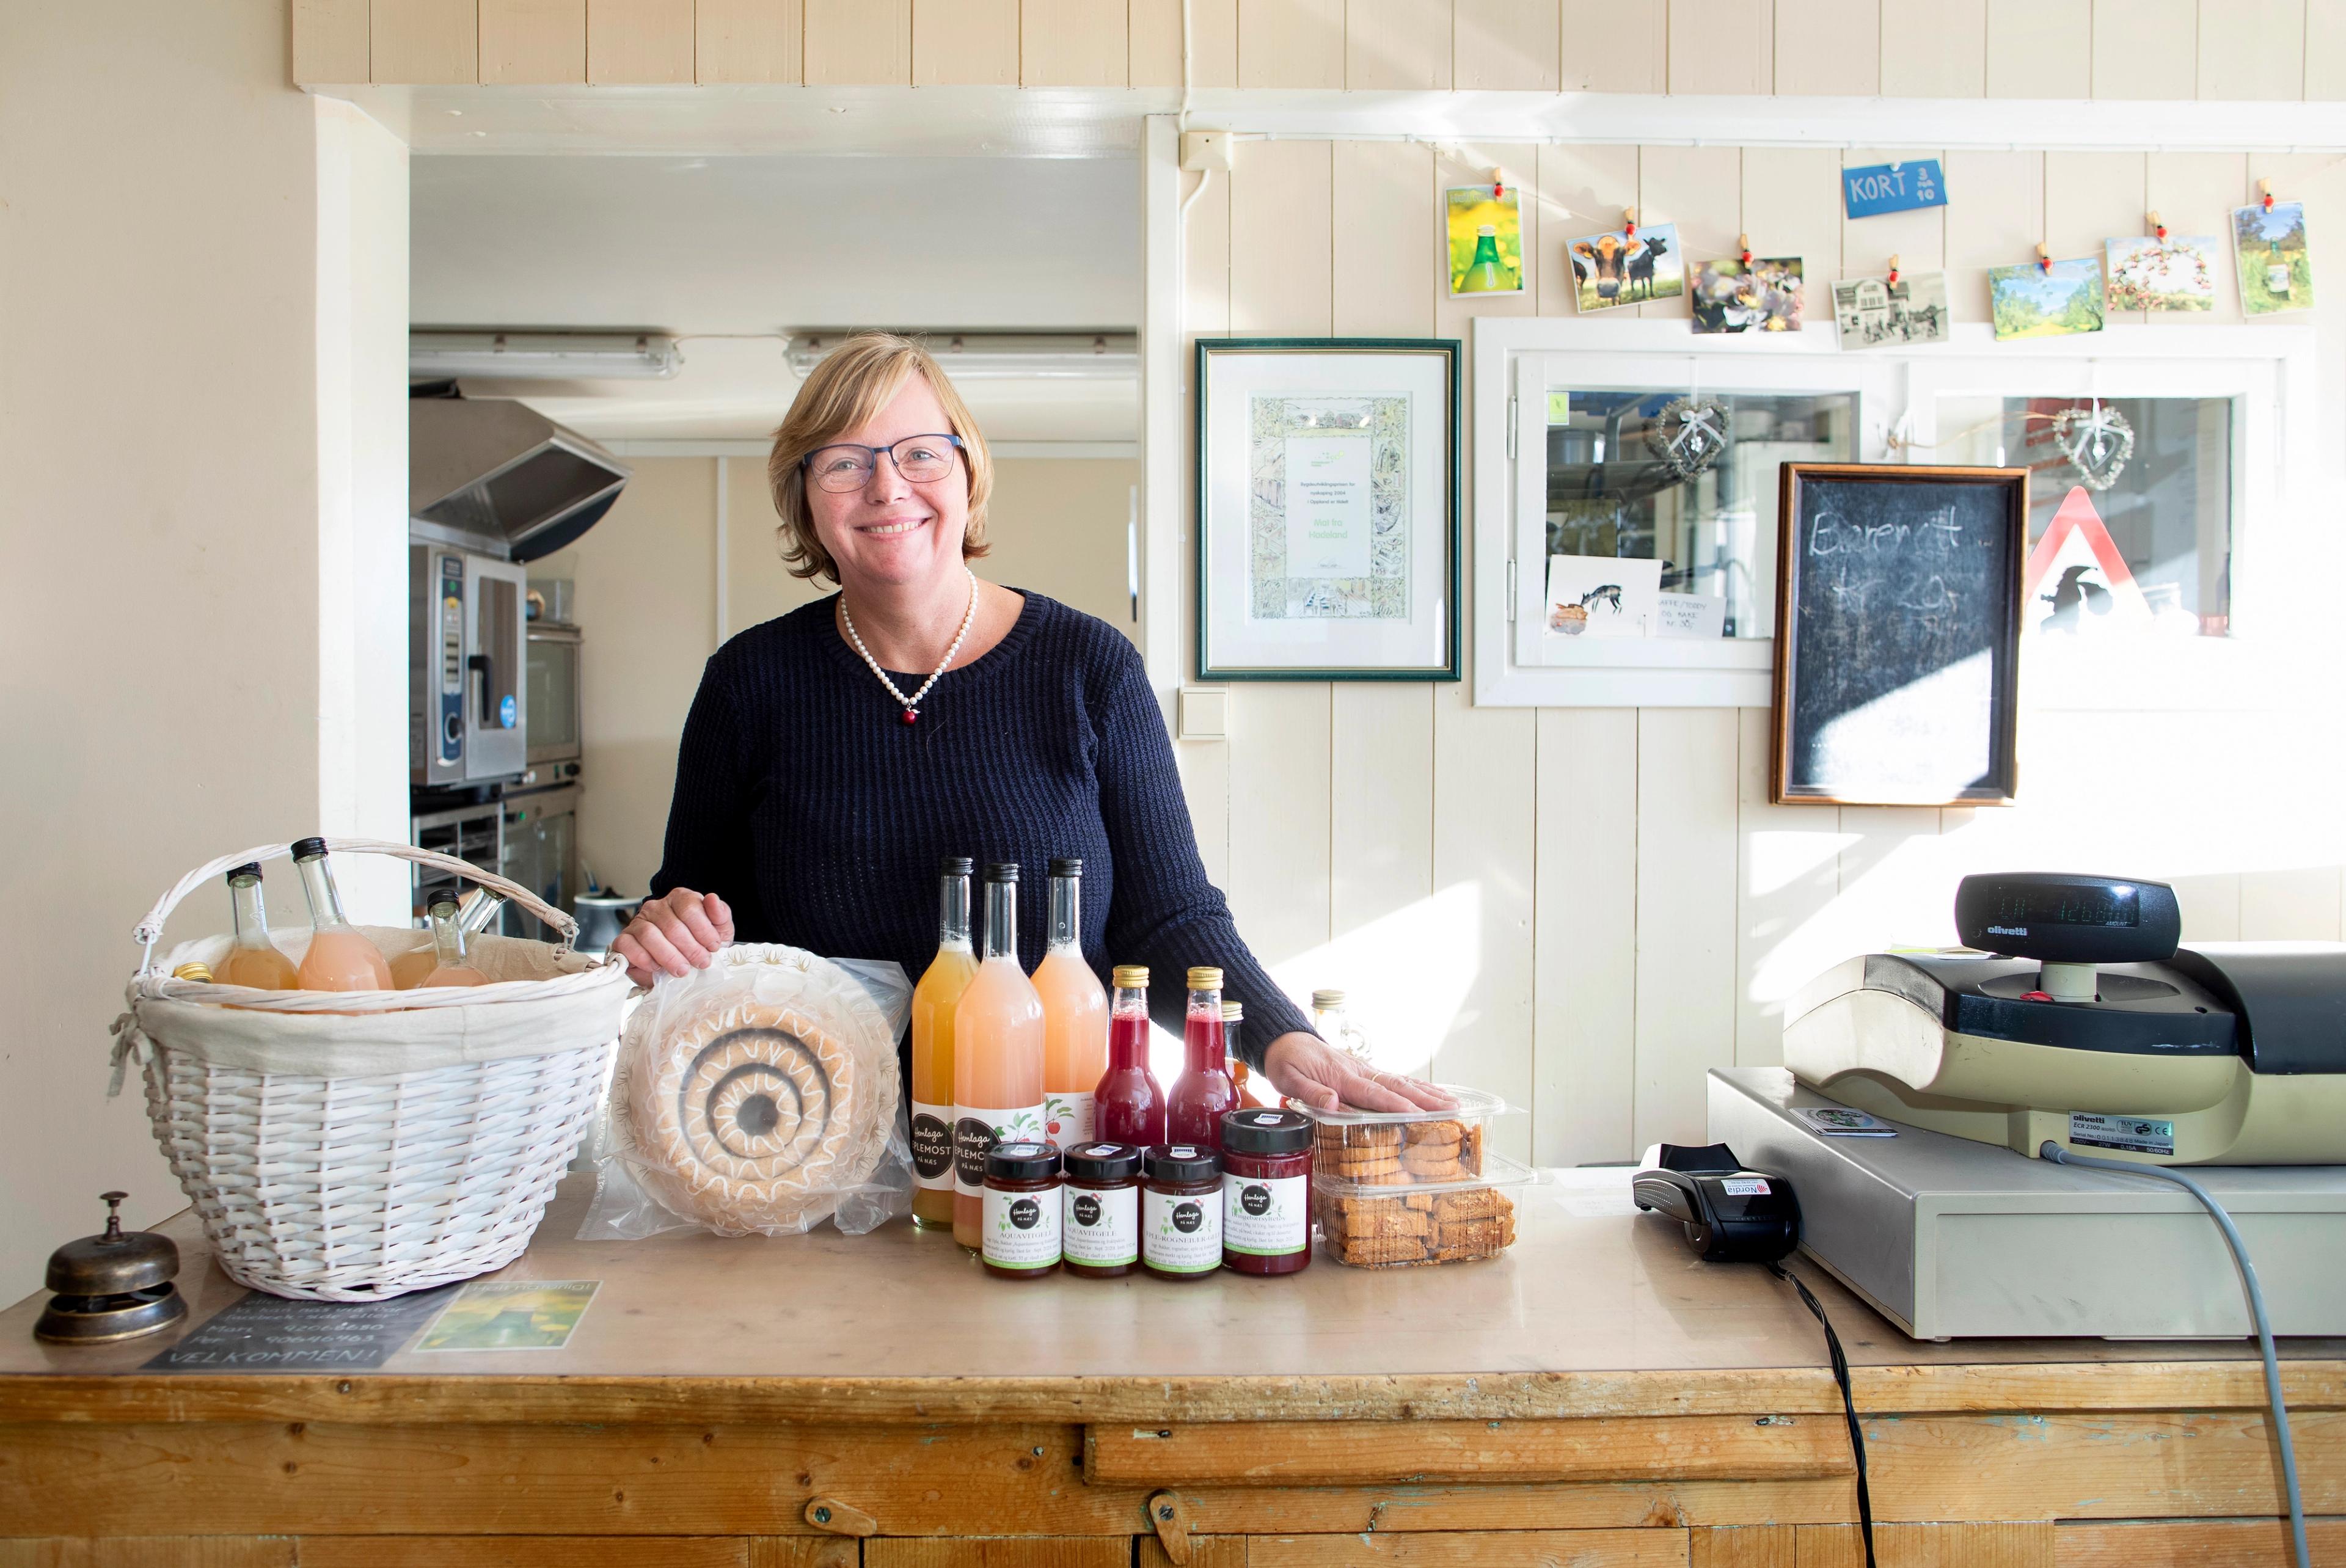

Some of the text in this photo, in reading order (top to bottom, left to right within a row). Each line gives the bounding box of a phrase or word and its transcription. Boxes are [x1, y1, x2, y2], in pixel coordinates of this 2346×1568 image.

[1918, 167, 1928, 181] 3
[1850, 172, 1906, 203] KORT
[1917, 188, 1934, 202] 10
[1331, 517, 1343, 526] fra
[1987, 925, 2028, 936] olivetti
[2073, 1115, 2105, 1124] olivetti
[915, 1128, 944, 1142] Hemlaga
[958, 1131, 990, 1148] Hemlaga
[912, 1140, 951, 1155] EPLEMOST
[955, 1146, 985, 1161] EPLEMO
[1244, 1194, 1267, 1203] Hemlaga
[1014, 1208, 1037, 1216] Hemlaga
[1076, 1205, 1097, 1214] Hemlaga
[1176, 1211, 1199, 1220] Hemlaga
[169, 1349, 378, 1364] VELKOMMEN!
